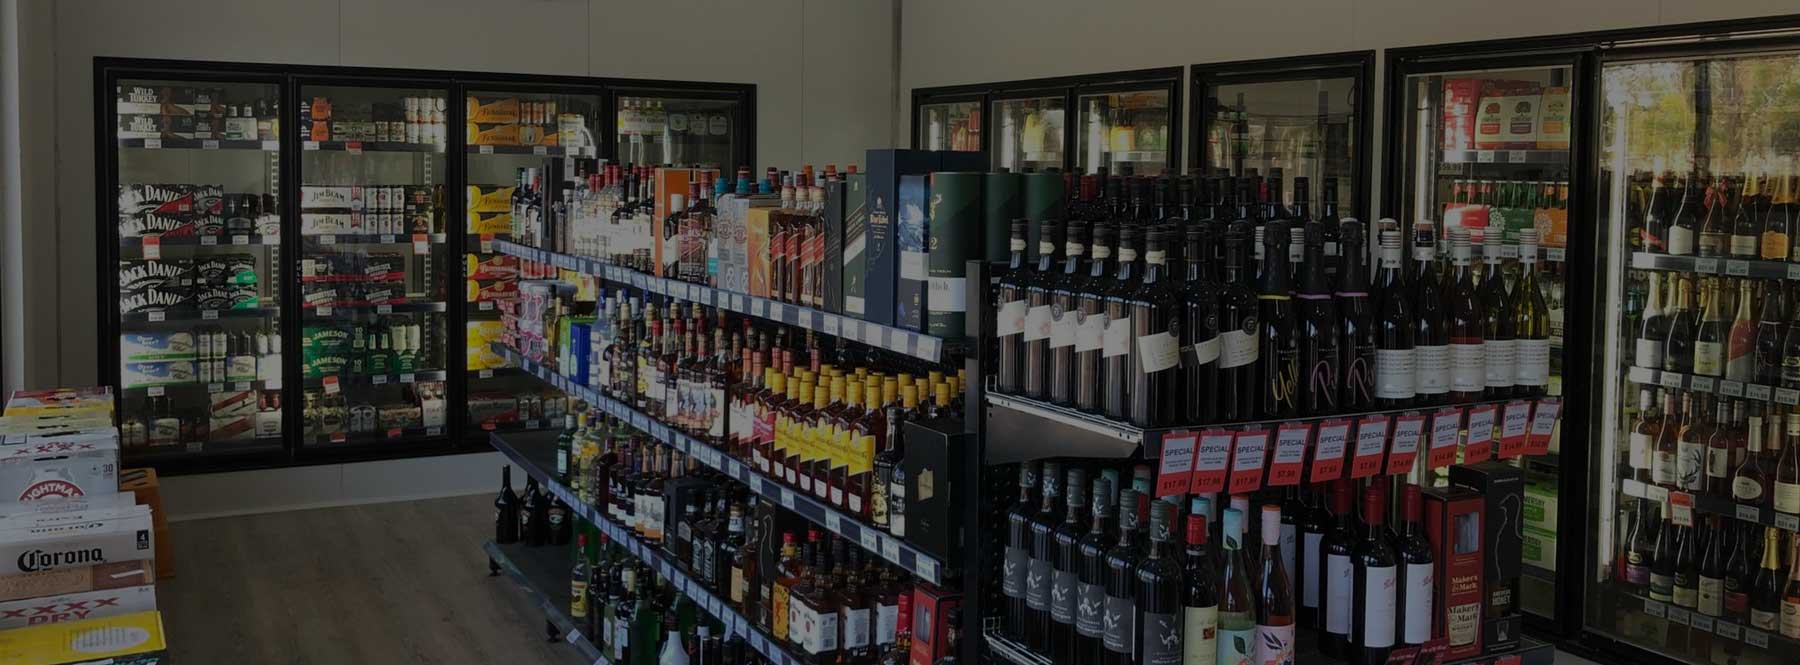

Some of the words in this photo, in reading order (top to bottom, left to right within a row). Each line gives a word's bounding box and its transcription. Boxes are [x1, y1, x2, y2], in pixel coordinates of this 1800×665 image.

[133, 87, 154, 95] WILD
[129, 93, 158, 103] TURKEY
[312, 329, 349, 341] JAMESON
[311, 356, 348, 367] JAMESON
[1279, 439, 1304, 447] SPECIAL
[1320, 435, 1345, 444] SPECIAL
[1165, 447, 1194, 457] SPECIAL
[1201, 445, 1229, 454] SPECIAL
[1237, 445, 1264, 454] SPECIAL
[103, 463, 114, 473] 30
[17, 548, 103, 572] Corona
[1, 597, 120, 618] XXXX
[28, 610, 92, 625] DRY
